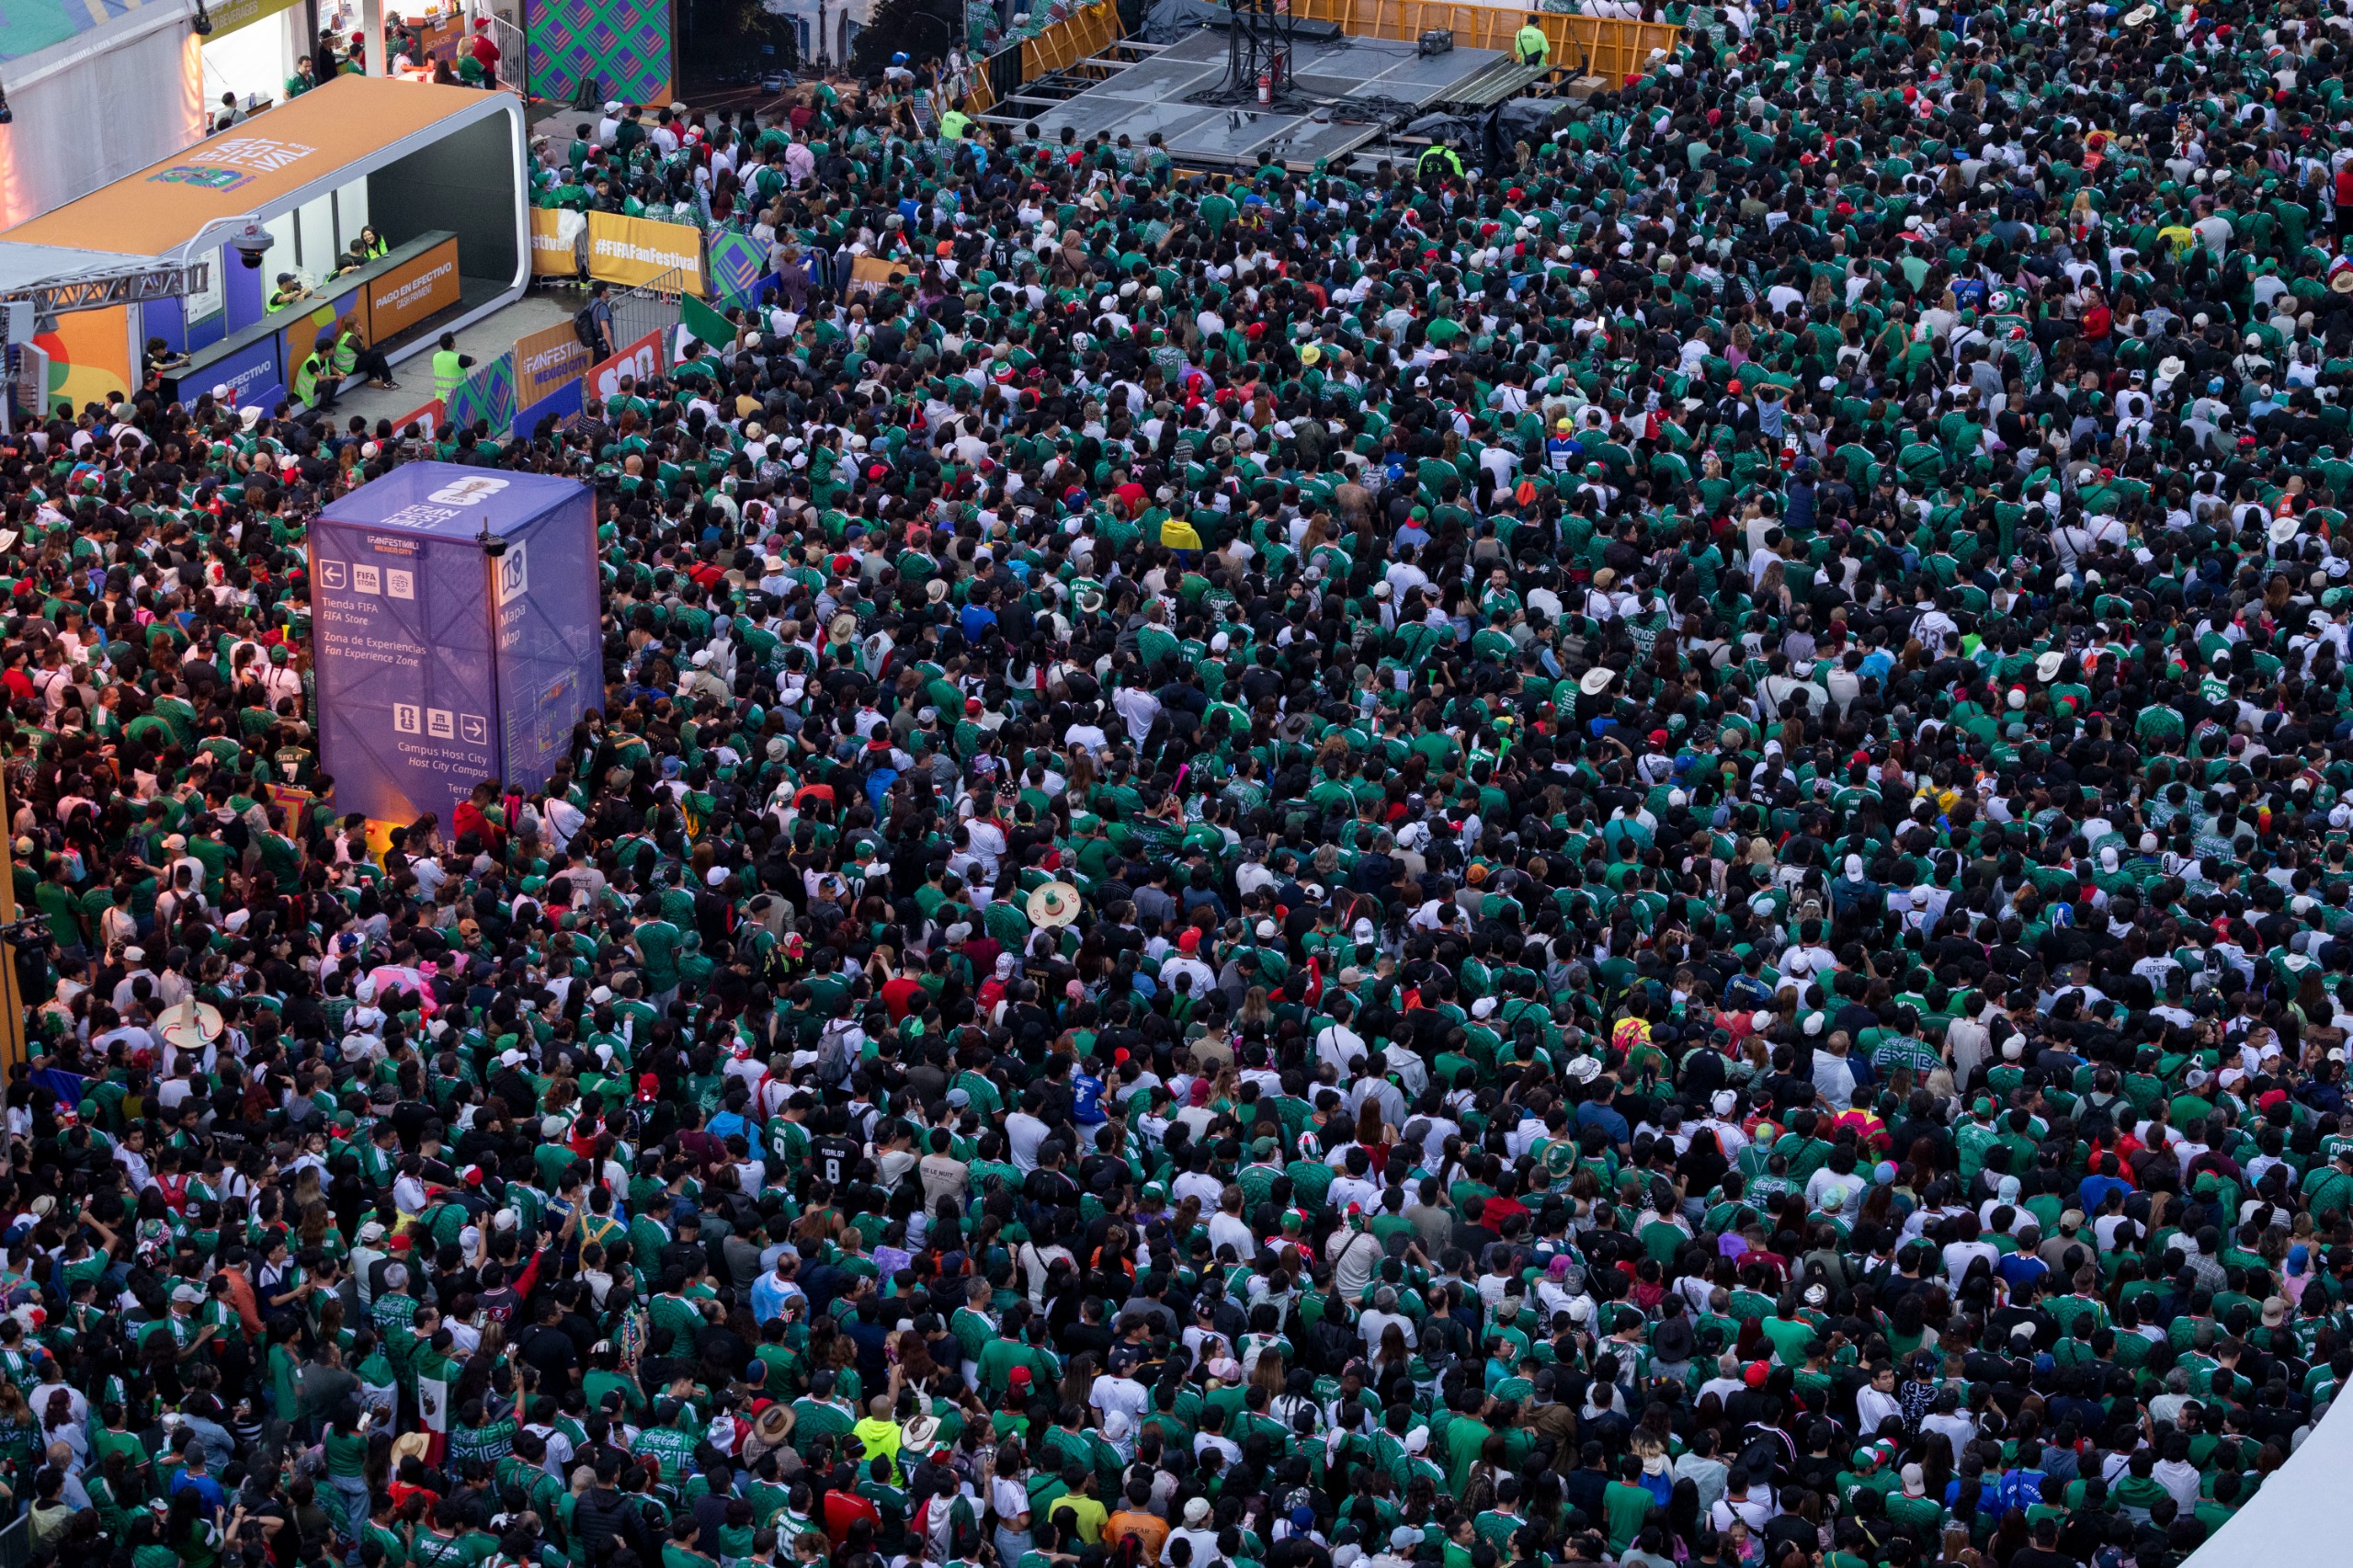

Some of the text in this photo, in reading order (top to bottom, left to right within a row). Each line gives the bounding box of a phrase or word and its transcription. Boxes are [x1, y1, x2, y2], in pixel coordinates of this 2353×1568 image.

[425, 34, 451, 51] SOMOS
[595, 238, 699, 272] #FIFAFanFestival
[376, 262, 452, 309] PAGO EN EFECTIVO
[396, 283, 433, 310] CASH PAYMENT
[227, 360, 271, 388] EFECTIVO
[534, 363, 568, 386] MEXICO
[568, 355, 588, 373] CITY
[374, 545, 398, 554] MEXICO
[357, 571, 377, 581] FIFA
[357, 579, 378, 588] STORE
[322, 597, 379, 613] Tienda FIFA
[323, 610, 369, 625] FIFA Store
[500, 604, 526, 628] Mapa
[501, 629, 521, 649] Map
[1628, 625, 1656, 641] SOMOS
[1919, 627, 1940, 649] 33
[324, 631, 426, 654] Zona de Experiencias
[324, 645, 419, 667] Fan Experience Zone
[2203, 683, 2228, 698] MEXICO
[398, 742, 487, 767] Campus Host City
[281, 763, 299, 783] 7
[408, 756, 489, 778] Host City Campus
[447, 783, 473, 796] Terra
[2200, 835, 2232, 849] Coca-Cola
[774, 1126, 788, 1138] RAÚL
[773, 1136, 786, 1161] 9
[821, 1148, 846, 1158] FIDALGO
[825, 1158, 840, 1184] 8
[1754, 1179, 1786, 1193] Coca-Cola
[546, 1200, 569, 1217] Corona
[376, 1298, 404, 1314] Coca-Cola
[644, 1432, 681, 1447] Coca-Cola
[1124, 1526, 1150, 1534] OSCAR
